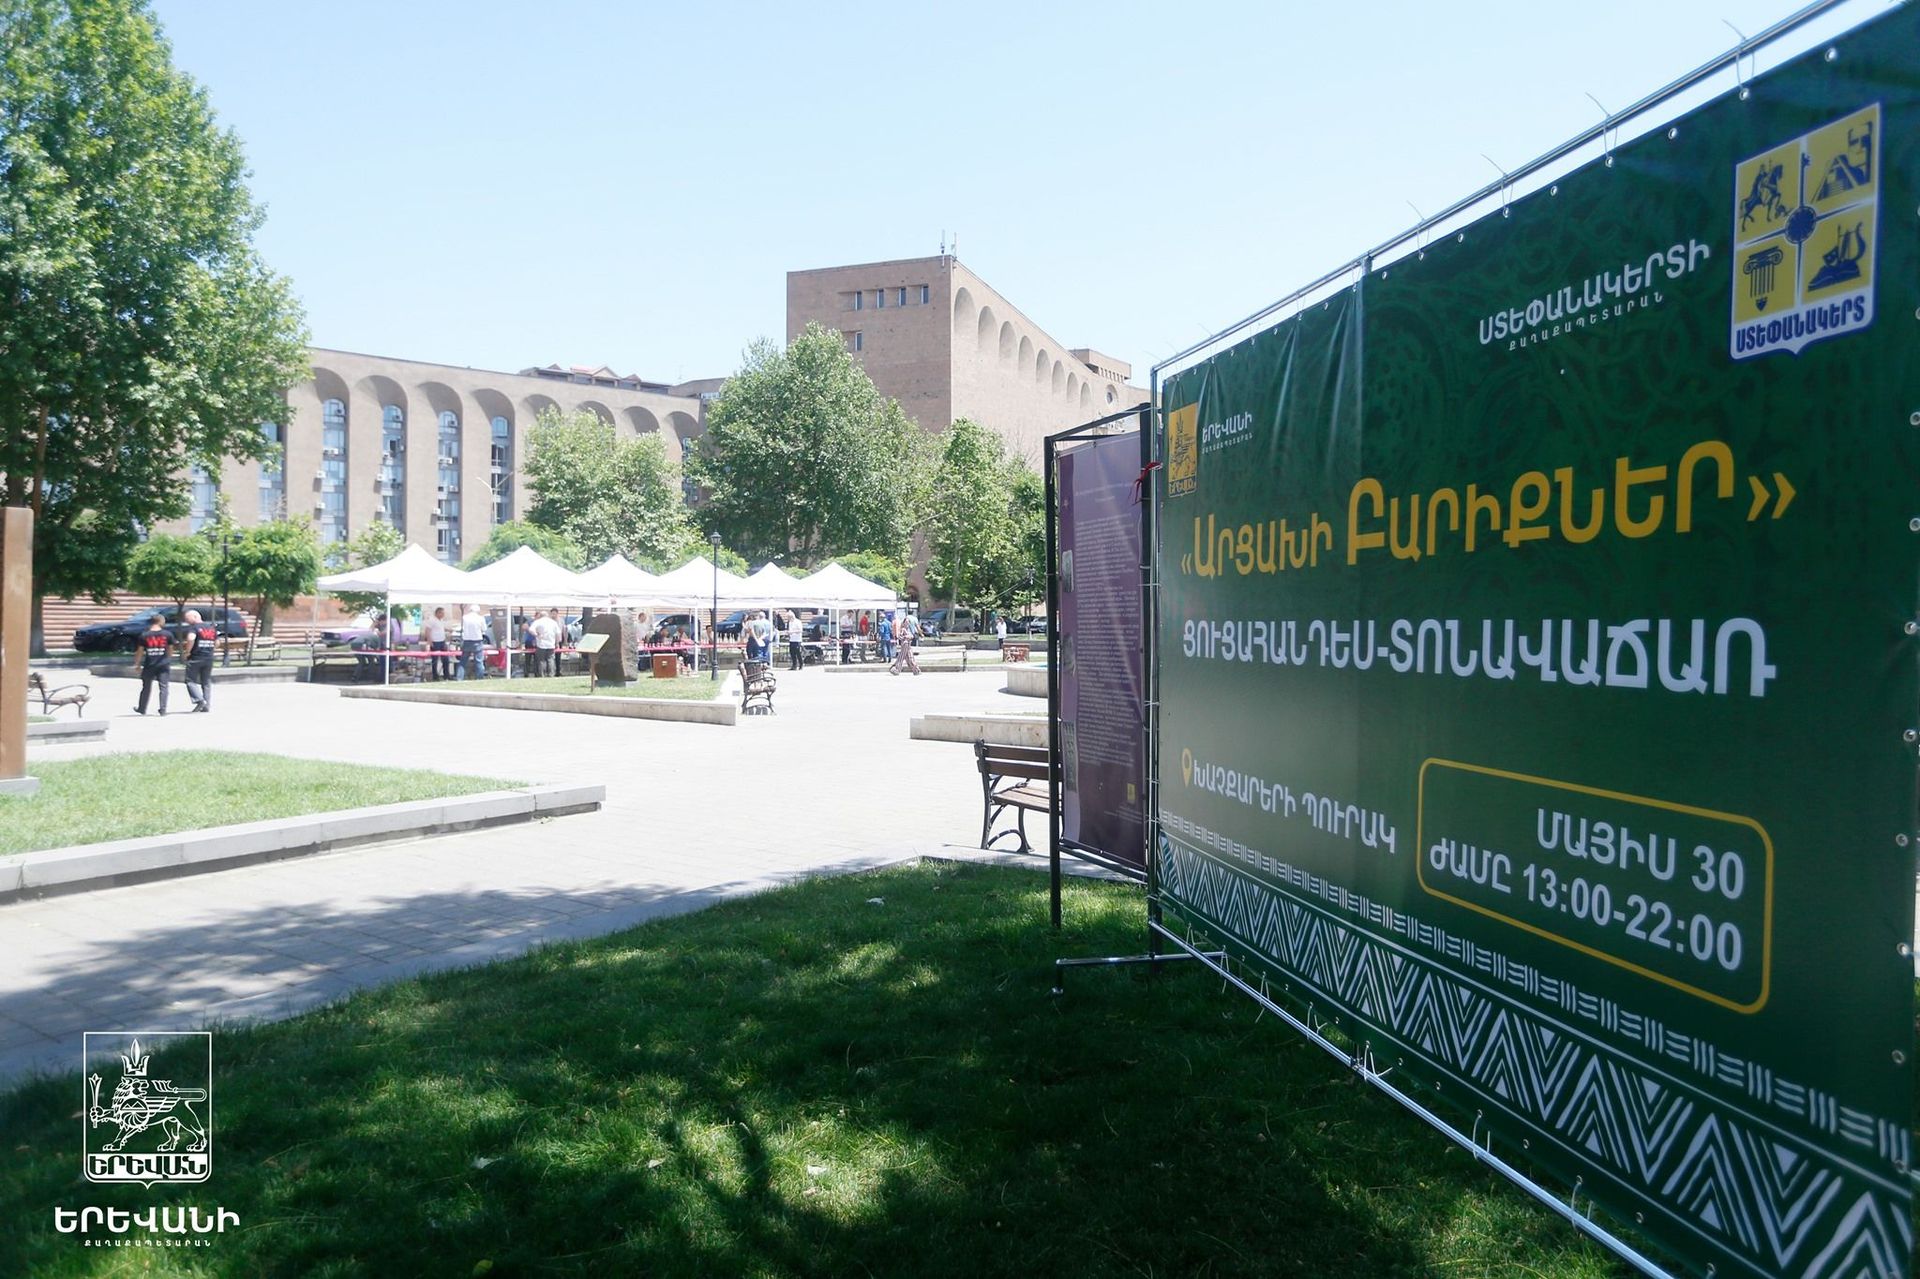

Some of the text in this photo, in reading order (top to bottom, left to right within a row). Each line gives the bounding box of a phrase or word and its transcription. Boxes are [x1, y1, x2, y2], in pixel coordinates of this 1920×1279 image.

[1479, 239, 1710, 345] ՍՏԵՓԱՆԱԿԵՐՏԻ
[1509, 291, 1663, 351] ՔԱՂԱՔԱՊԵՏԱՐԱՆ
[1736, 295, 1865, 353] ՍՏԵՓԱՆԱԿԵՐՏ
[1202, 411, 1252, 443] ԵՐԵՎԱՆԻ
[1183, 617, 1777, 697] ՑՈՒՑԱՀԱՆԴԵՍ-ՏՈՆԱՎԱՃԱՌ
[1193, 759, 1396, 854] ԽԱՉՔԱՐԵՐԻ ՊՈՒՐԱԿ
[1537, 808, 1744, 899] ՄԱՅԻՍ 30
[1429, 837, 1742, 971] ԺԱՄԸ 13:00-22:00
